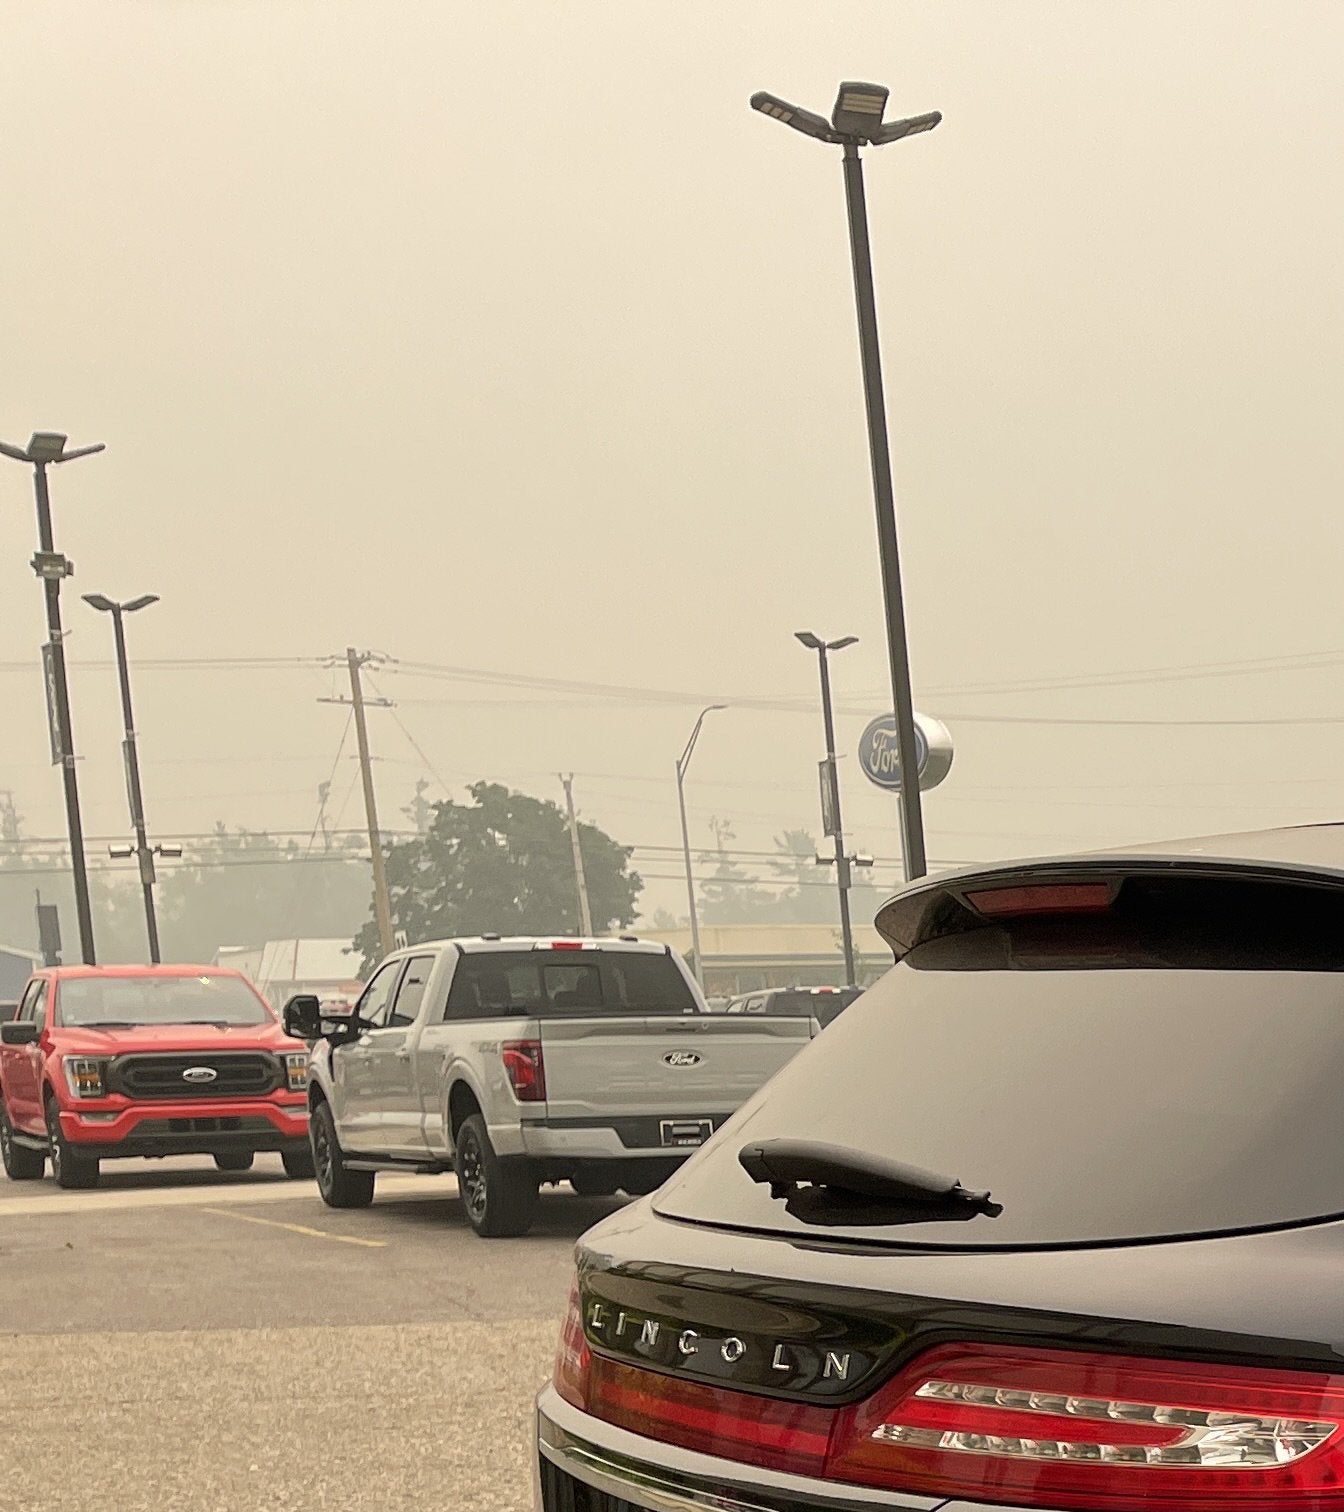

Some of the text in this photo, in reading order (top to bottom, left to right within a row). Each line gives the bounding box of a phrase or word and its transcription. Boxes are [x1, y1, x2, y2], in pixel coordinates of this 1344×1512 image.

[870, 728, 900, 774] For
[669, 1052, 695, 1065] Ford
[591, 1303, 850, 1380] LINCOLN
